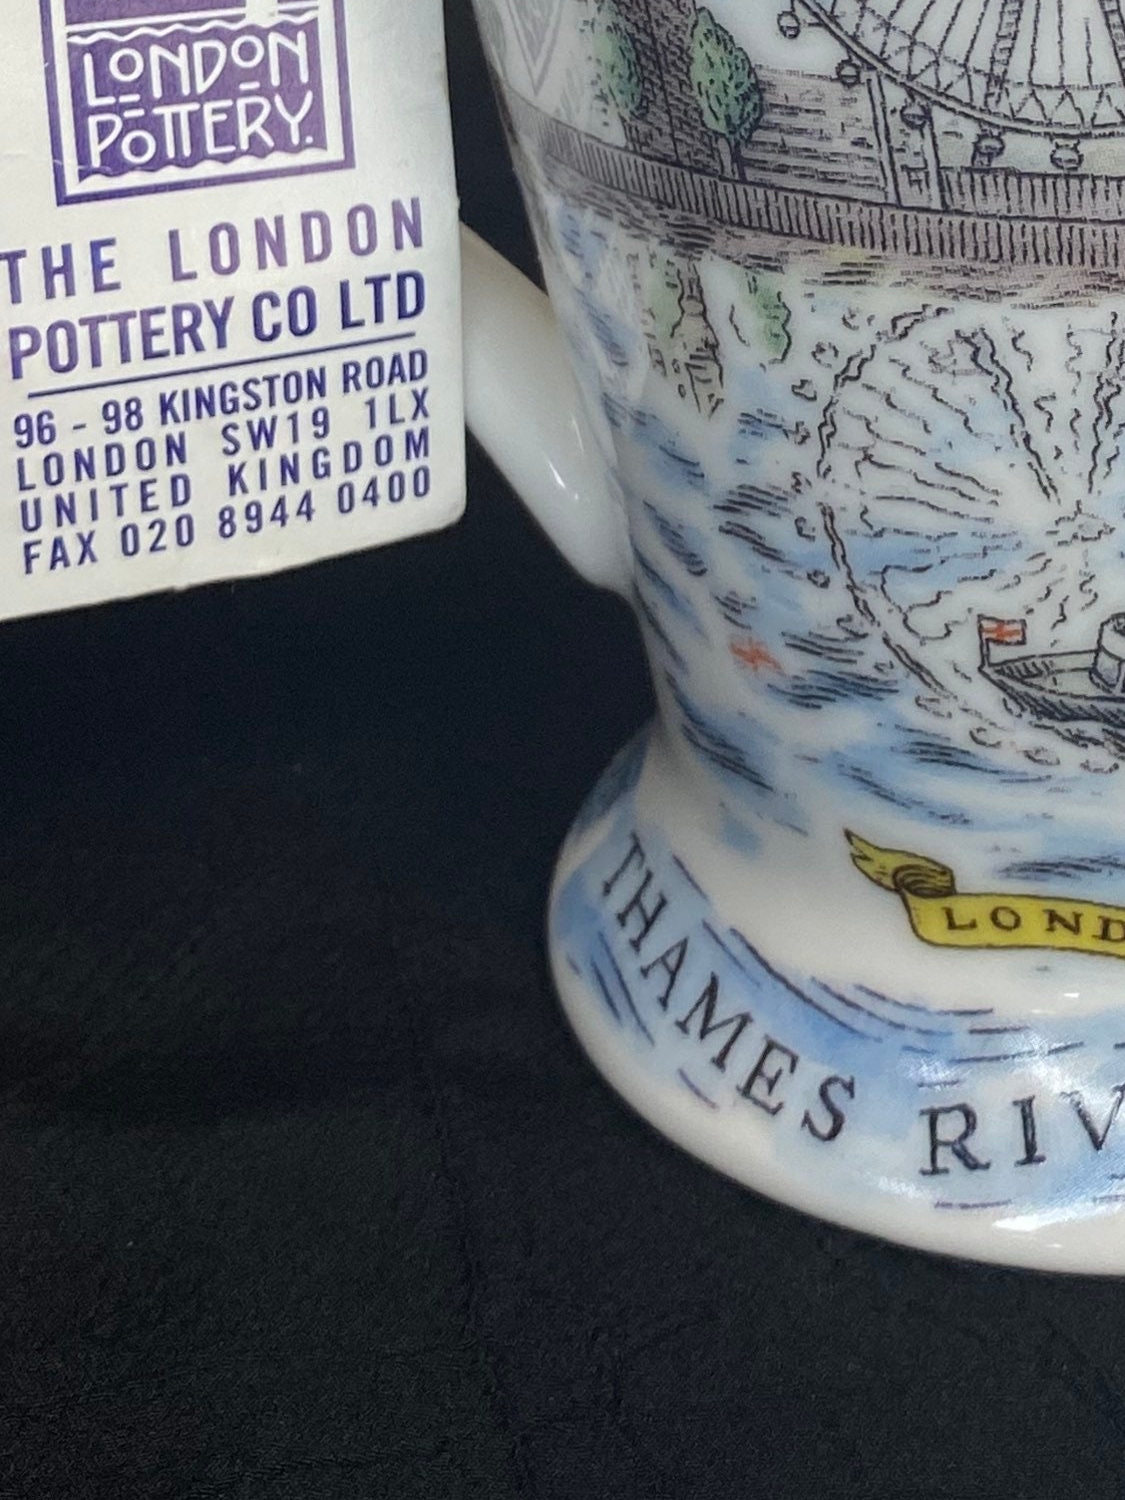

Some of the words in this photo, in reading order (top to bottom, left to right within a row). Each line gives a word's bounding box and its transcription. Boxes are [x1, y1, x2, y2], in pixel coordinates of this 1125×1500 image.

[83, 31, 310, 107] LONDON
[1, 237, 122, 305] THE
[168, 197, 424, 282] LONDON
[8, 296, 235, 380] POTTERY
[252, 285, 317, 343] CO
[339, 269, 426, 330] LTD
[13, 410, 57, 449] 96
[102, 399, 144, 435] 98
[160, 366, 327, 426] KINGSTON
[342, 348, 429, 394] ROAD
[17, 432, 188, 492] LONDON
[222, 406, 330, 457] SW19
[365, 388, 430, 429] 1LX
[20, 473, 192, 534] UNITED
[228, 426, 430, 497] KINGDOM
[23, 530, 98, 575] FAX
[120, 515, 195, 557] 020
[219, 490, 315, 539] 8944
[337, 465, 431, 514] 0400
[602, 832, 855, 1143] THAMES
